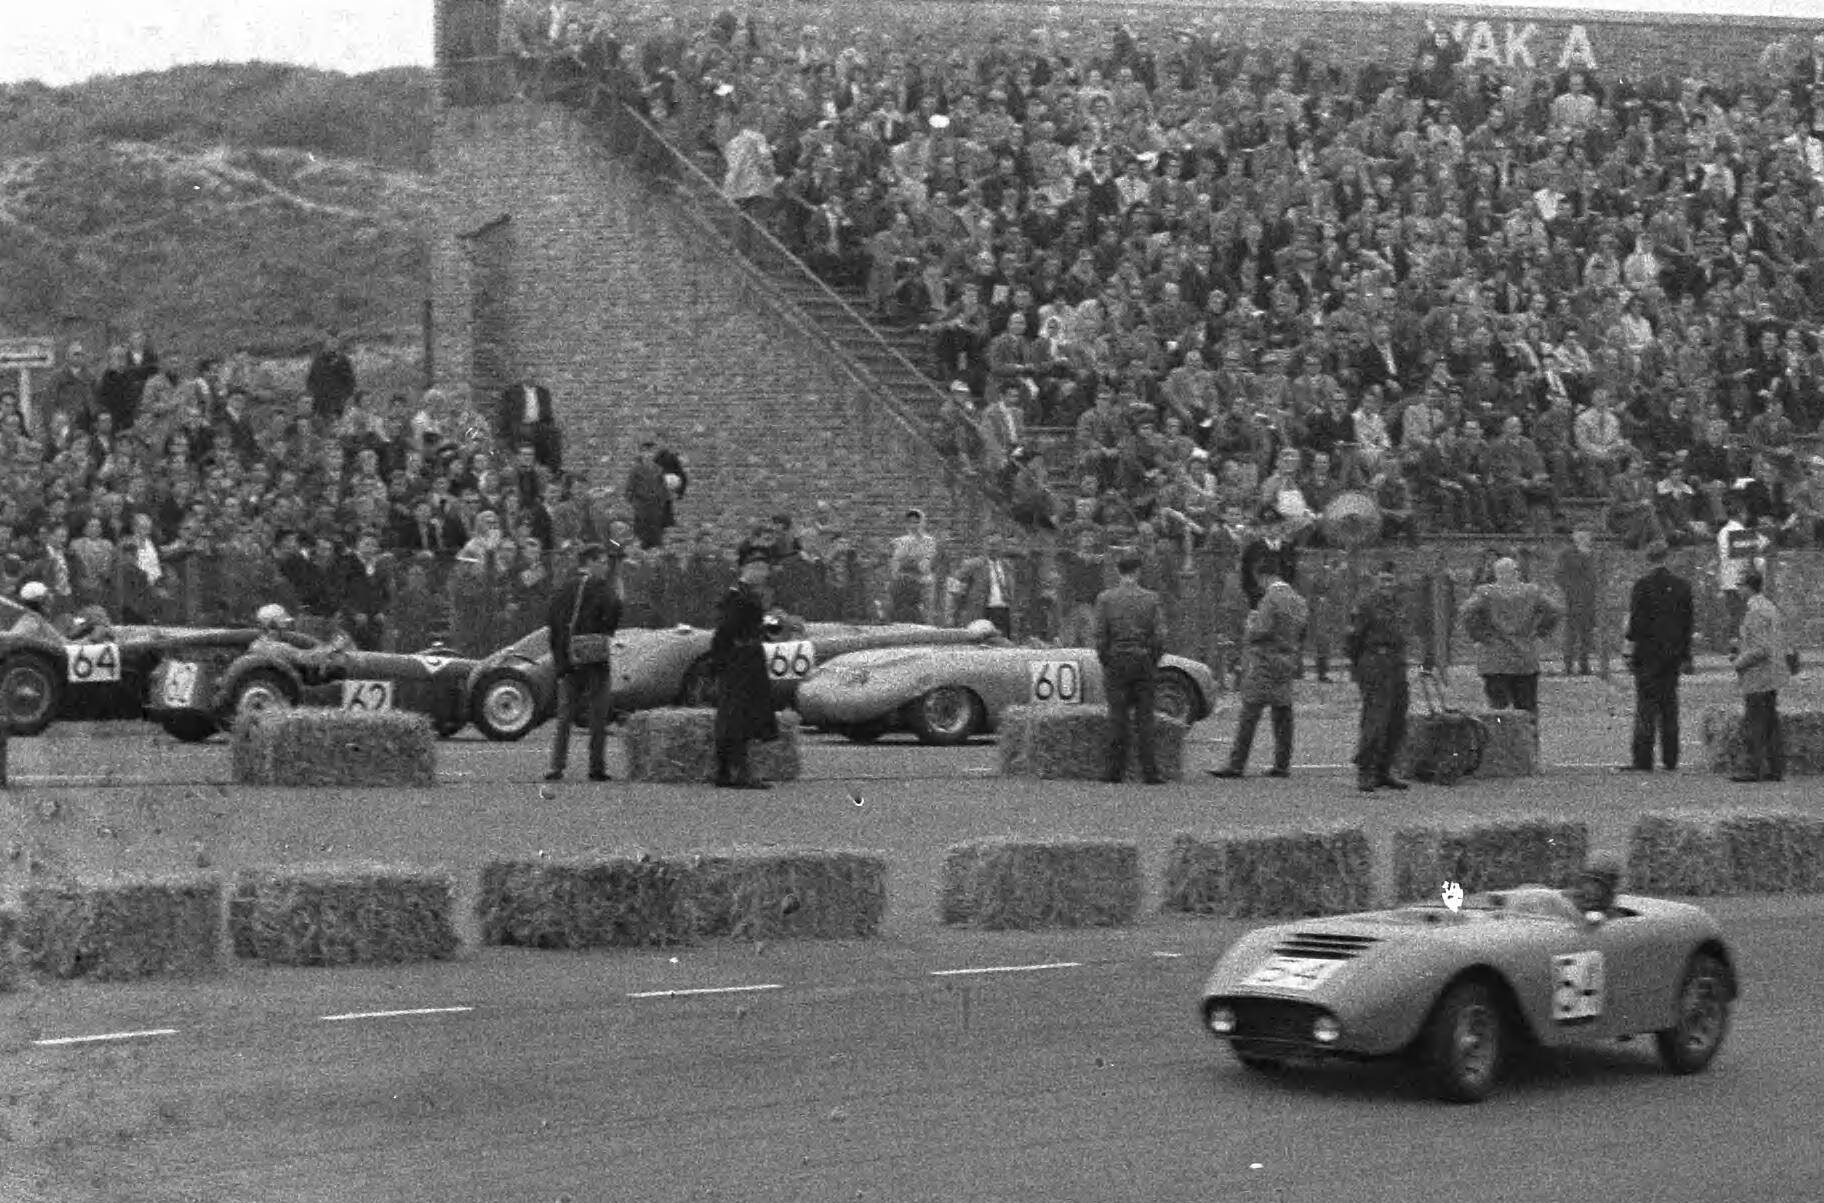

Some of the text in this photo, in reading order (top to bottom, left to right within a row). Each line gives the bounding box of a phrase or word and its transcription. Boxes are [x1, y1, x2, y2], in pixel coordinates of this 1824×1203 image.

[1554, 24, 1598, 70] A
[74, 645, 119, 678] 64
[769, 645, 811, 677] 66
[1033, 662, 1079, 700] 60
